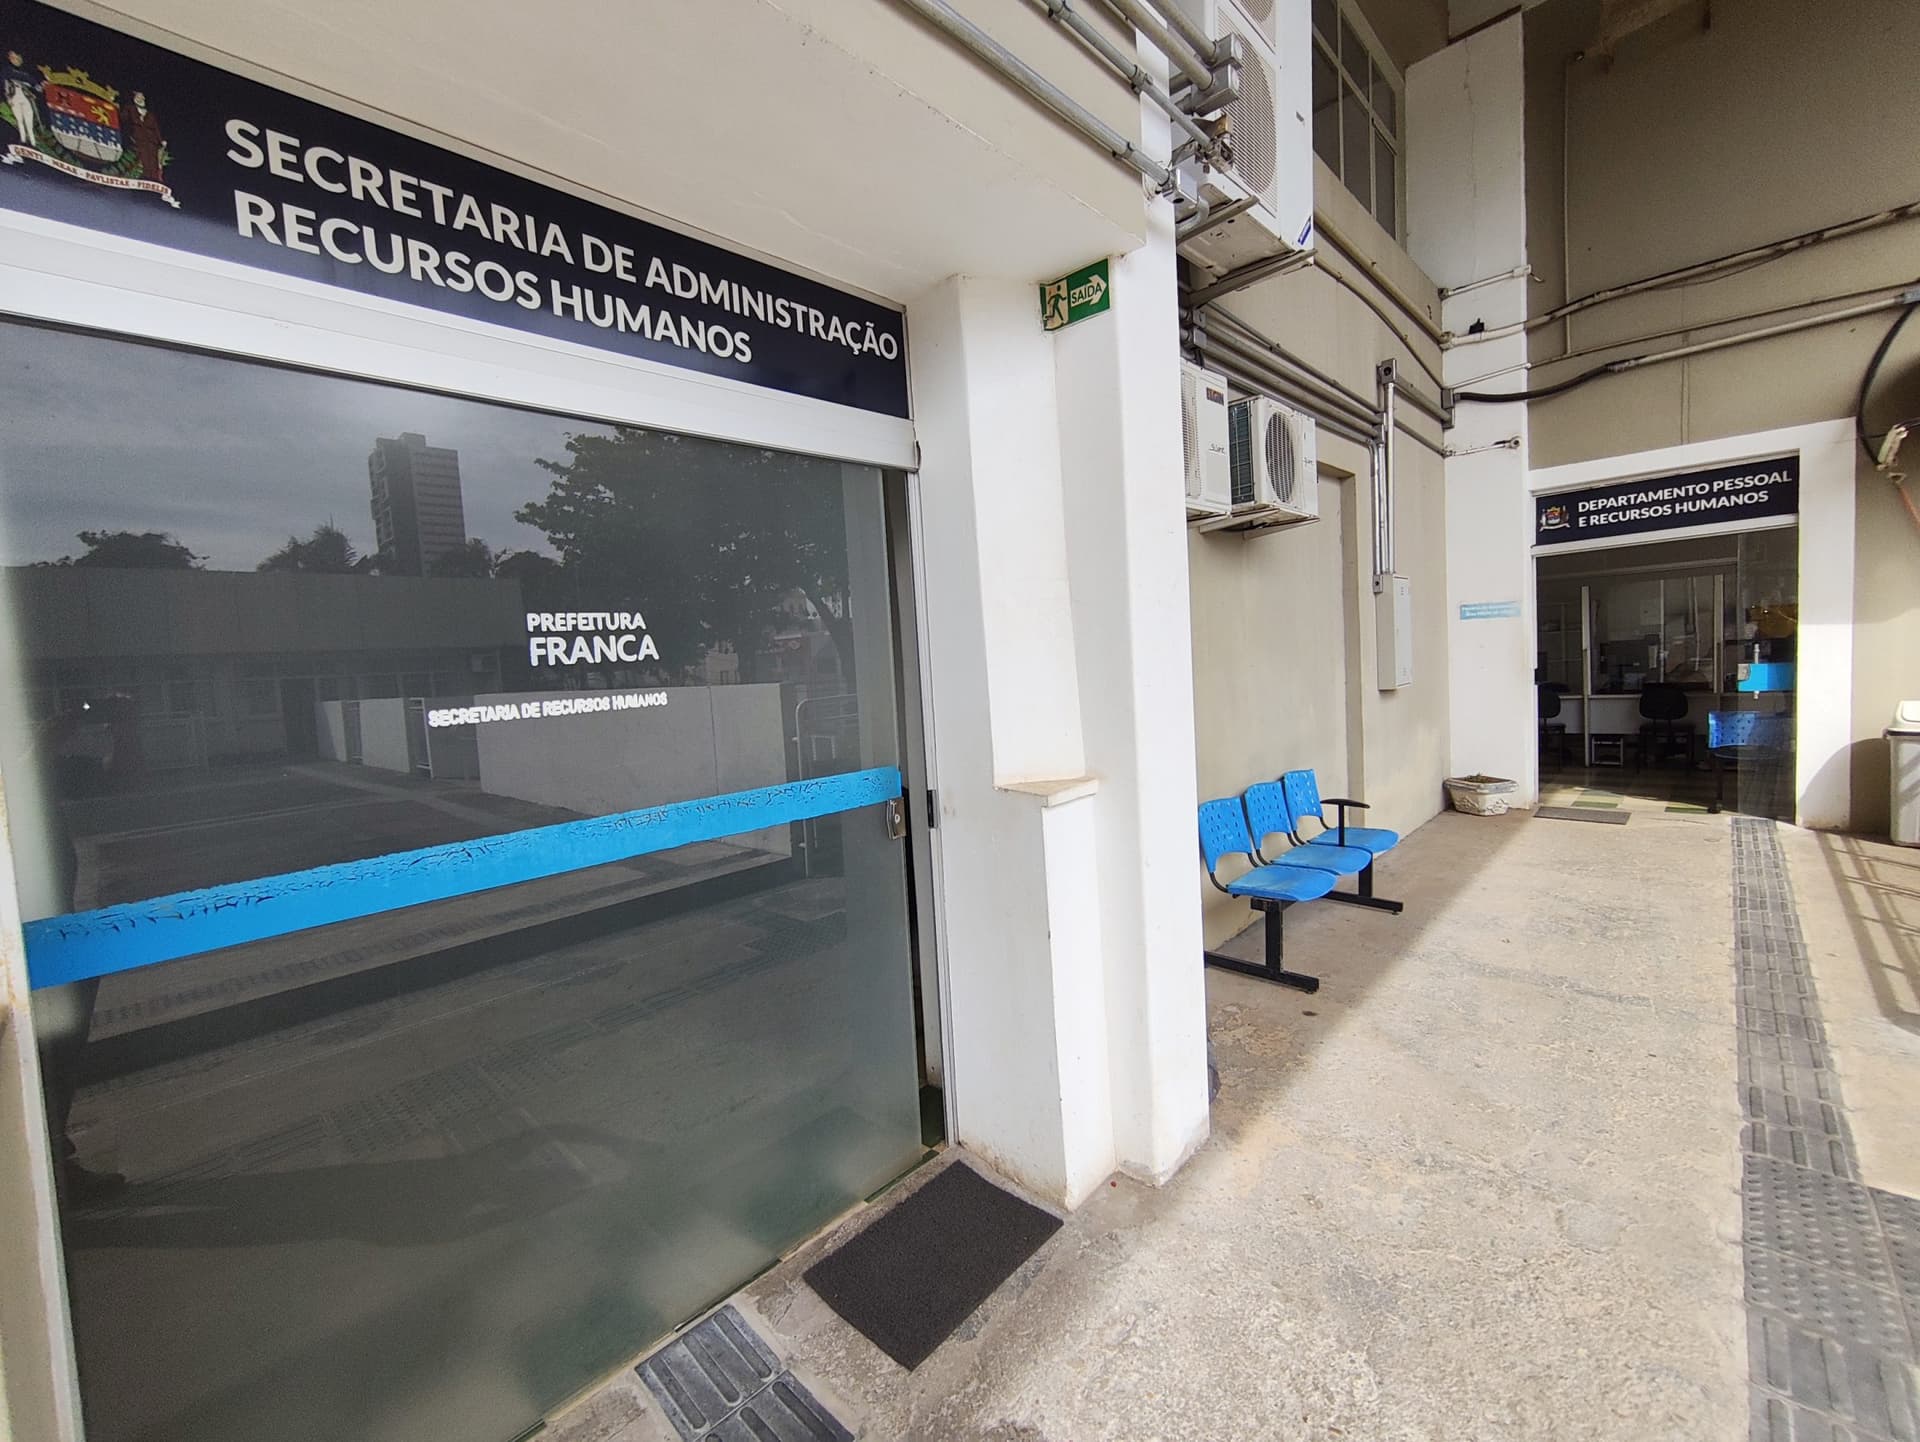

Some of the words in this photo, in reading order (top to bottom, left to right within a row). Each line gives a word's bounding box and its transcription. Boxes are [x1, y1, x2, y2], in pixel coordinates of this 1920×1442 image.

[225, 119, 575, 265] SECRETARIA
[581, 233, 637, 283] DE
[645, 257, 898, 361] ADMINISTRAÇÃO
[234, 190, 541, 310] RECURSOS
[550, 279, 752, 363] HUMANOS
[1578, 482, 1710, 513] DEPARTAMENTO
[1712, 470, 1792, 493] PESSOAL
[1578, 516, 1588, 528] E
[1589, 504, 1673, 526] RECURSOS
[1675, 490, 1769, 515] HUMANOS
[526, 612, 647, 632] PREFEITURA
[529, 634, 660, 667] FRANCA
[428, 703, 521, 728] SECRETARIA
[521, 701, 542, 719] DE
[542, 696, 611, 717] RECURSOS
[612, 691, 668, 711] HUMANOS
